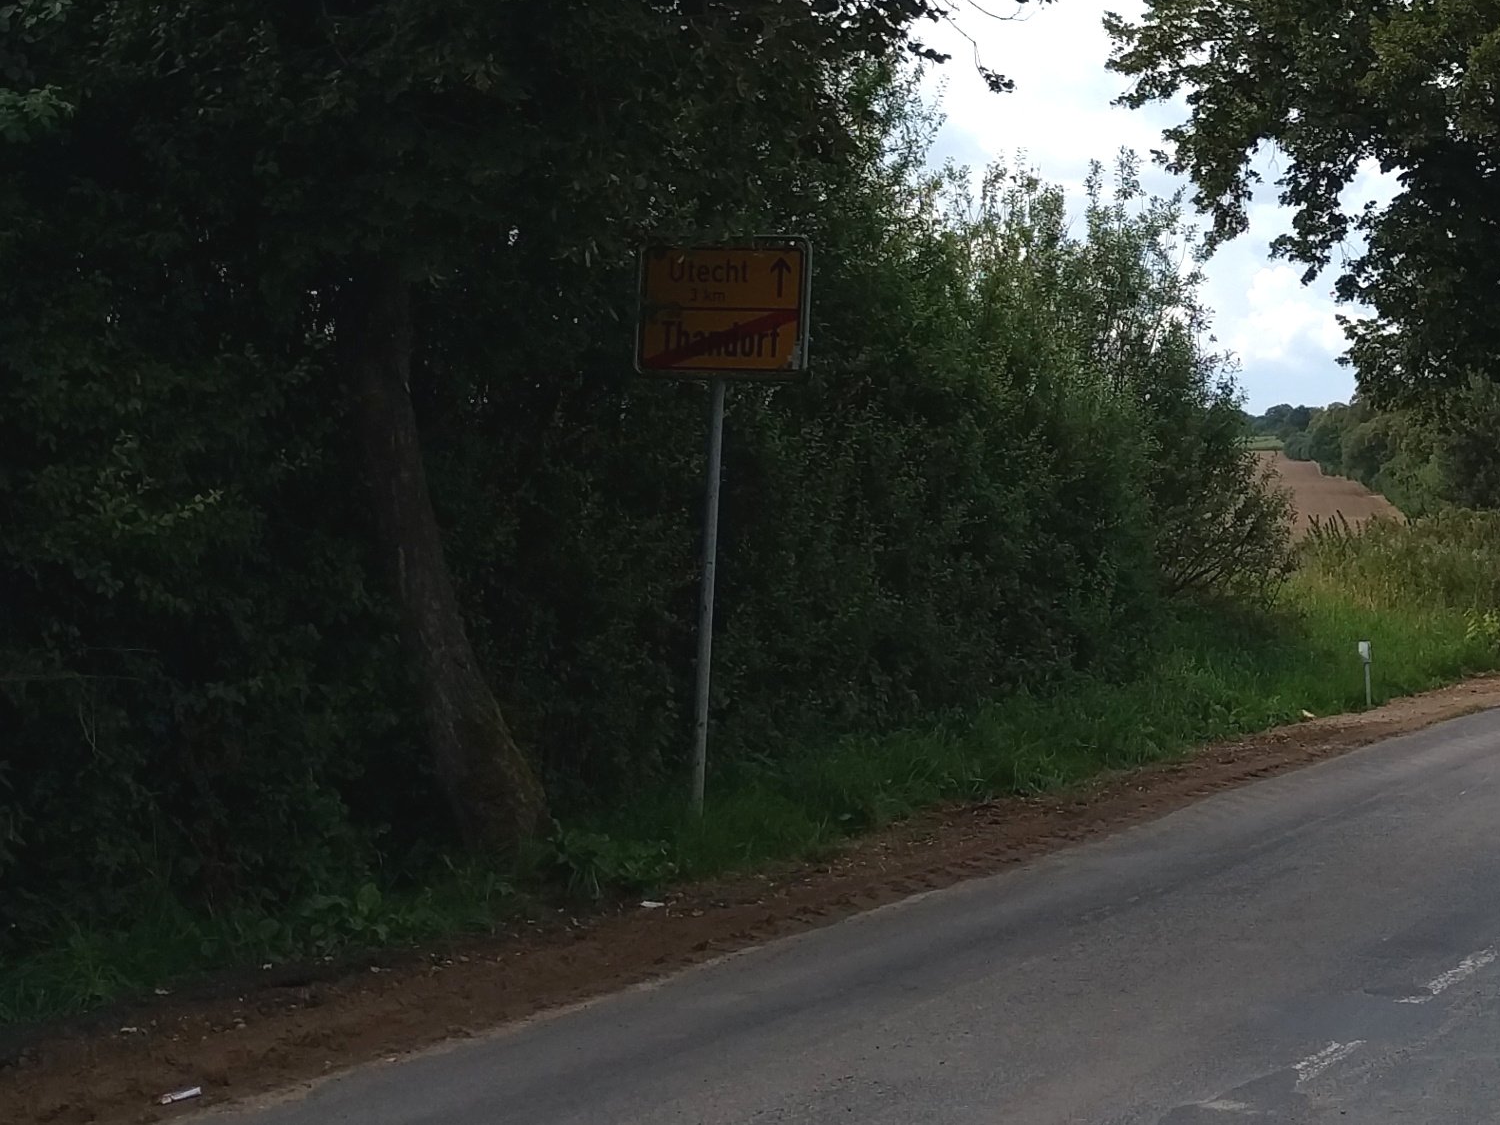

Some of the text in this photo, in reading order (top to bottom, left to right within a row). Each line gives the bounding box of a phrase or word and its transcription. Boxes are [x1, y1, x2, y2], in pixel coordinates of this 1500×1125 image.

[669, 258, 749, 284] Utecht
[689, 288, 726, 302] 3 km
[661, 320, 780, 358] Thandorf
